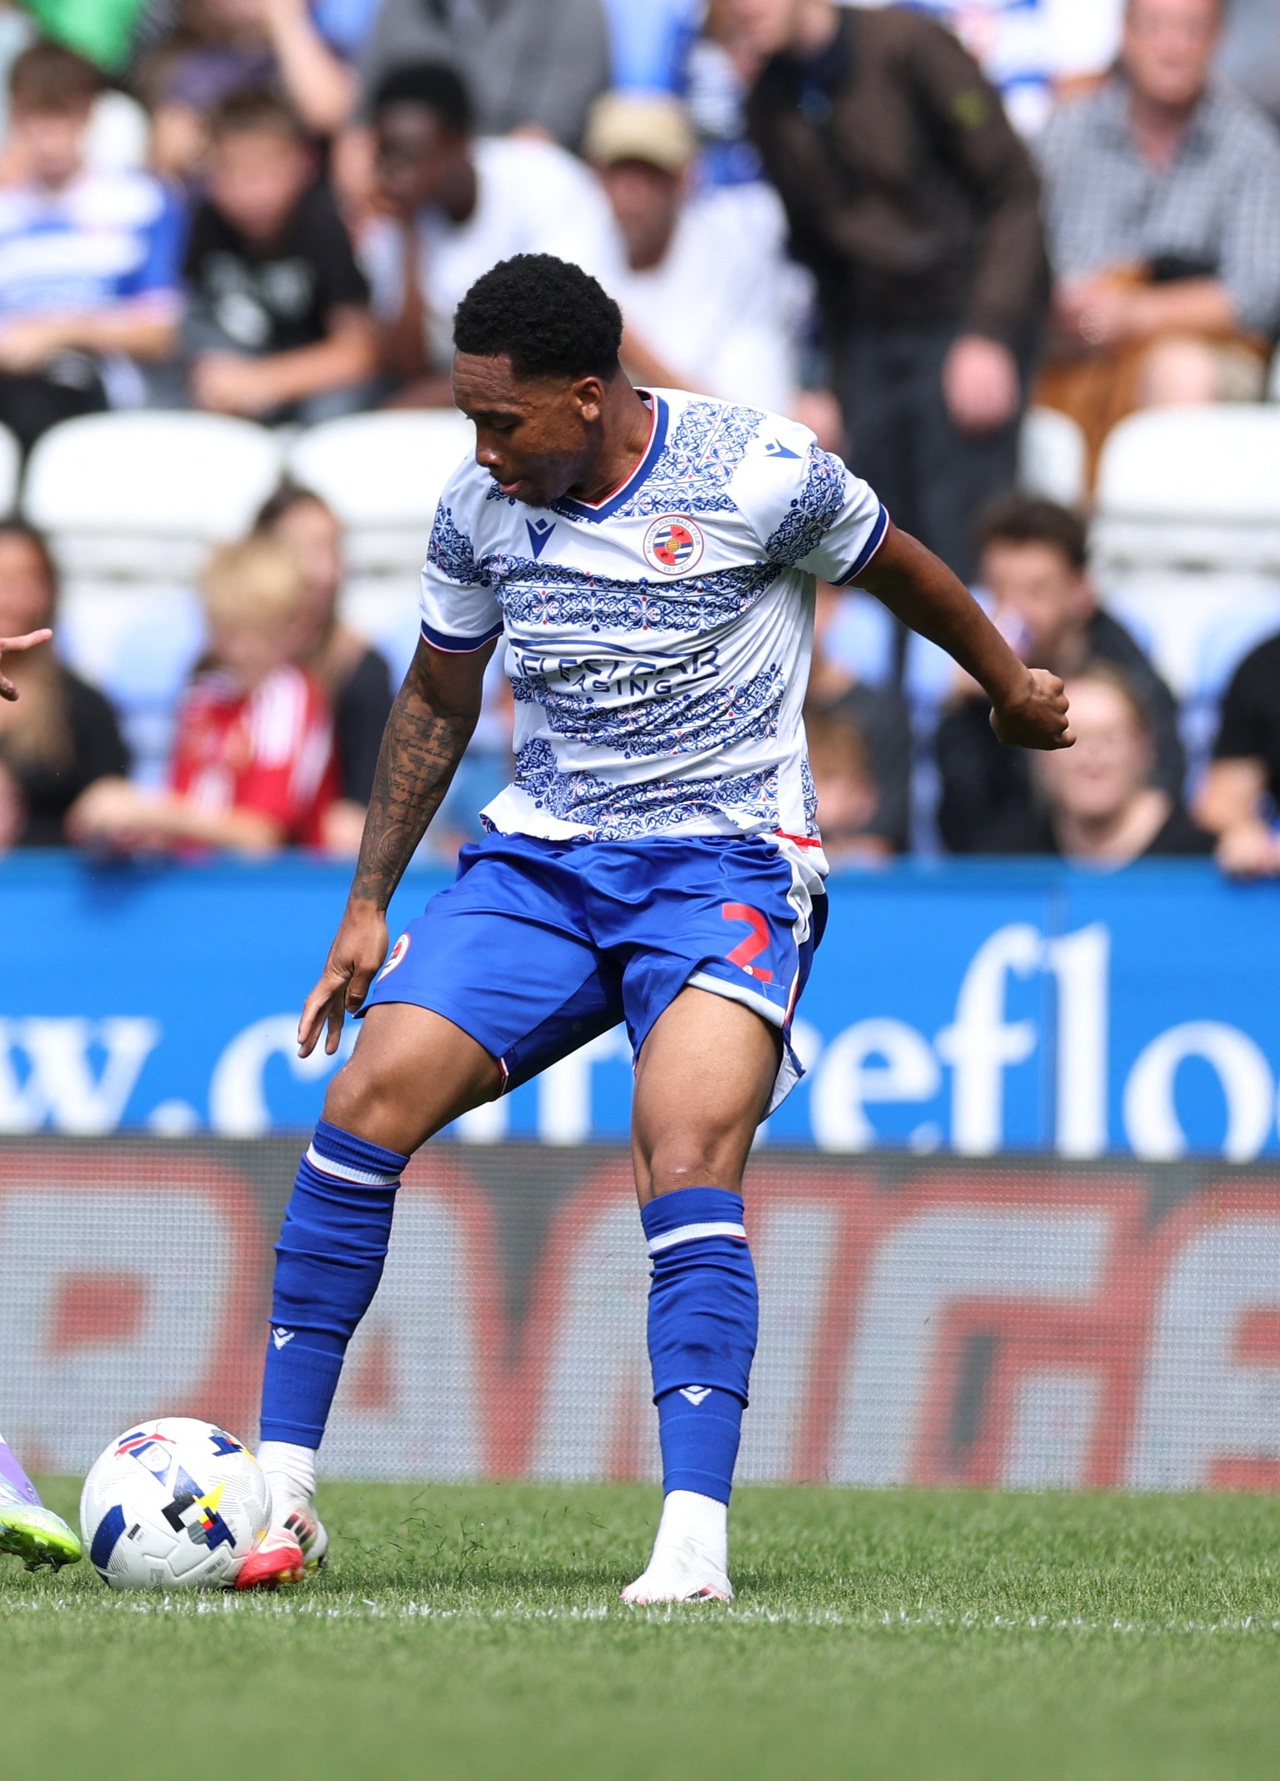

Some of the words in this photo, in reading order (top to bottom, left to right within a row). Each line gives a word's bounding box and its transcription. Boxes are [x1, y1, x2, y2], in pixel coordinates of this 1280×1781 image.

[659, 517, 692, 532] FOOTBALL
[690, 527, 701, 546] CLUB
[722, 902, 773, 983] 2
